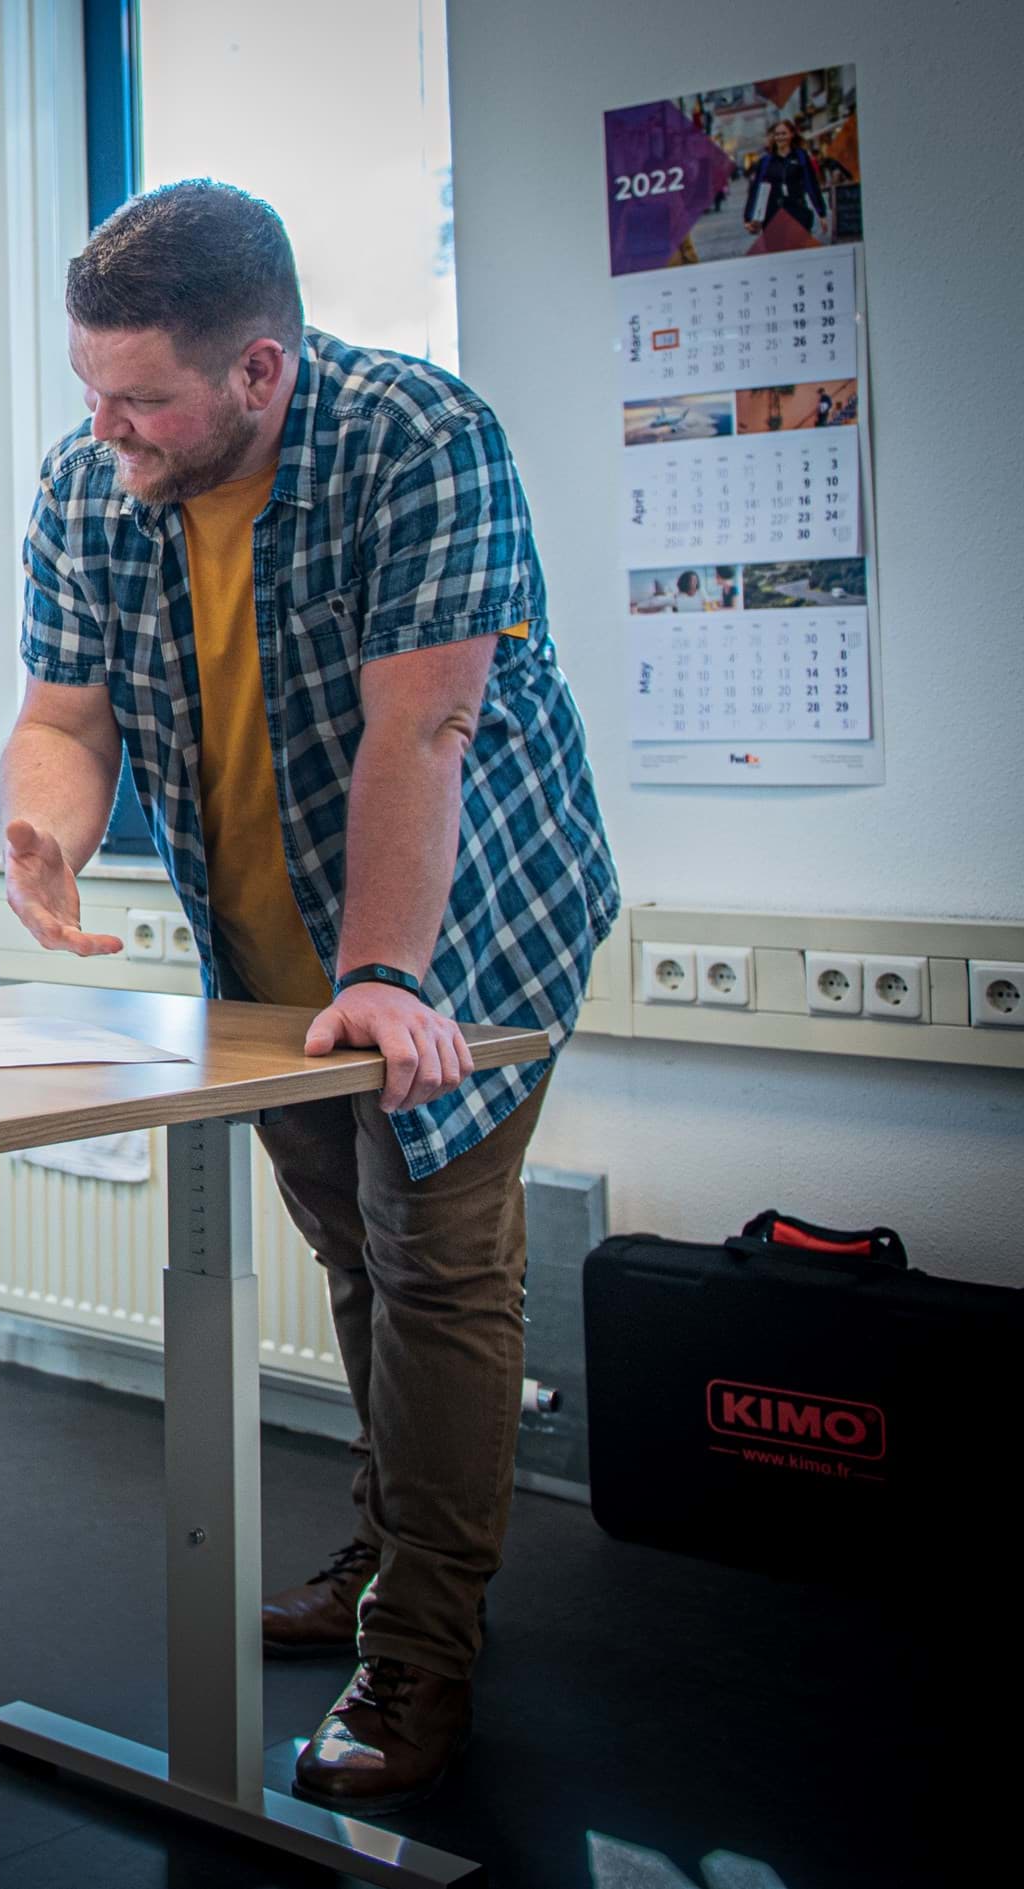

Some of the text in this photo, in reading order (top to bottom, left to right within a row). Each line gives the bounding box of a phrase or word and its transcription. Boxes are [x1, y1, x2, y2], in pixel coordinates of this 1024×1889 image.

[615, 167, 684, 201] 2022
[798, 285, 805, 297] 5
[826, 281, 834, 293] 6
[792, 301, 805, 313] 12
[821, 298, 835, 310] 13
[792, 318, 807, 330] 19
[821, 315, 835, 327] 20
[629, 314, 641, 362] March
[793, 335, 807, 348] 26
[821, 332, 836, 345] 27
[803, 460, 810, 472] 2
[831, 458, 838, 470] 3
[804, 477, 811, 489] 9
[826, 475, 839, 487] 10
[798, 494, 811, 506] 16
[826, 492, 839, 504] 17
[631, 489, 647, 525] April
[798, 511, 811, 523] 23
[825, 509, 838, 521] 24
[797, 528, 810, 540] 30
[840, 632, 846, 643] 1
[811, 650, 818, 662] 7
[840, 649, 847, 661] 8
[639, 661, 654, 694] May
[806, 667, 819, 679] 14
[834, 666, 848, 679] 15
[806, 684, 819, 696] 21
[834, 683, 848, 696] 22
[807, 701, 820, 713] 28
[835, 700, 849, 713] 29
[742, 1448, 851, 1480] www.kimo.fr
